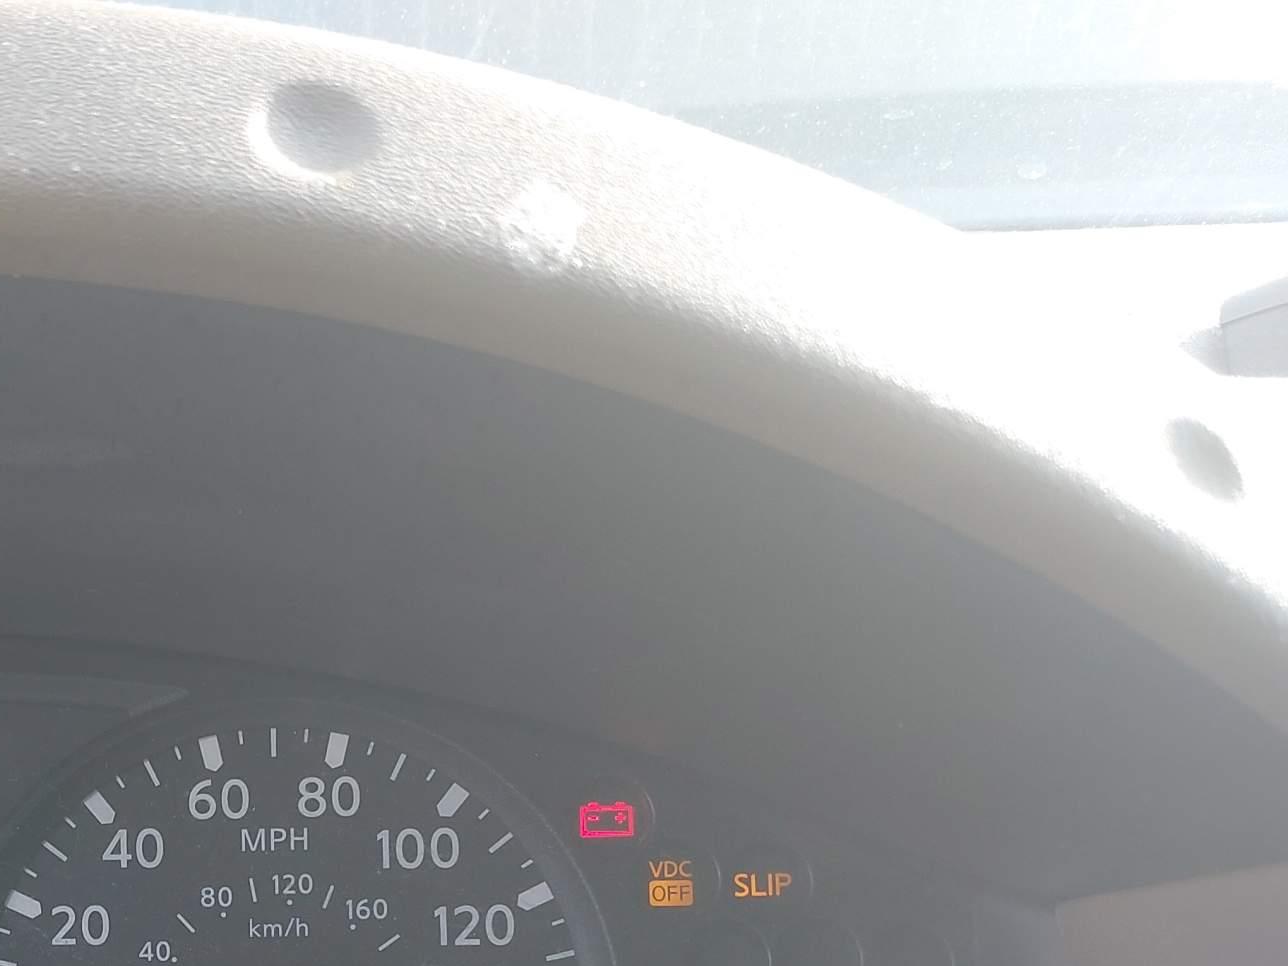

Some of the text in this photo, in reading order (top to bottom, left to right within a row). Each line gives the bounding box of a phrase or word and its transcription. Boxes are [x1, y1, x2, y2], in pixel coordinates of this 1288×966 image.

[187, 779, 250, 820] 60
[297, 776, 361, 817] 80
[102, 828, 165, 869] 40
[240, 828, 309, 852] MPH
[376, 828, 460, 869] 100
[649, 860, 693, 878] VDC
[200, 887, 233, 907] 80
[272, 875, 313, 896] 120
[651, 885, 692, 902] OFF
[734, 873, 793, 897] SLIP
[346, 899, 388, 920] 160
[50, 905, 110, 946] 20
[248, 916, 310, 940] km/h
[433, 904, 515, 946] 120
[139, 941, 171, 961] 40
